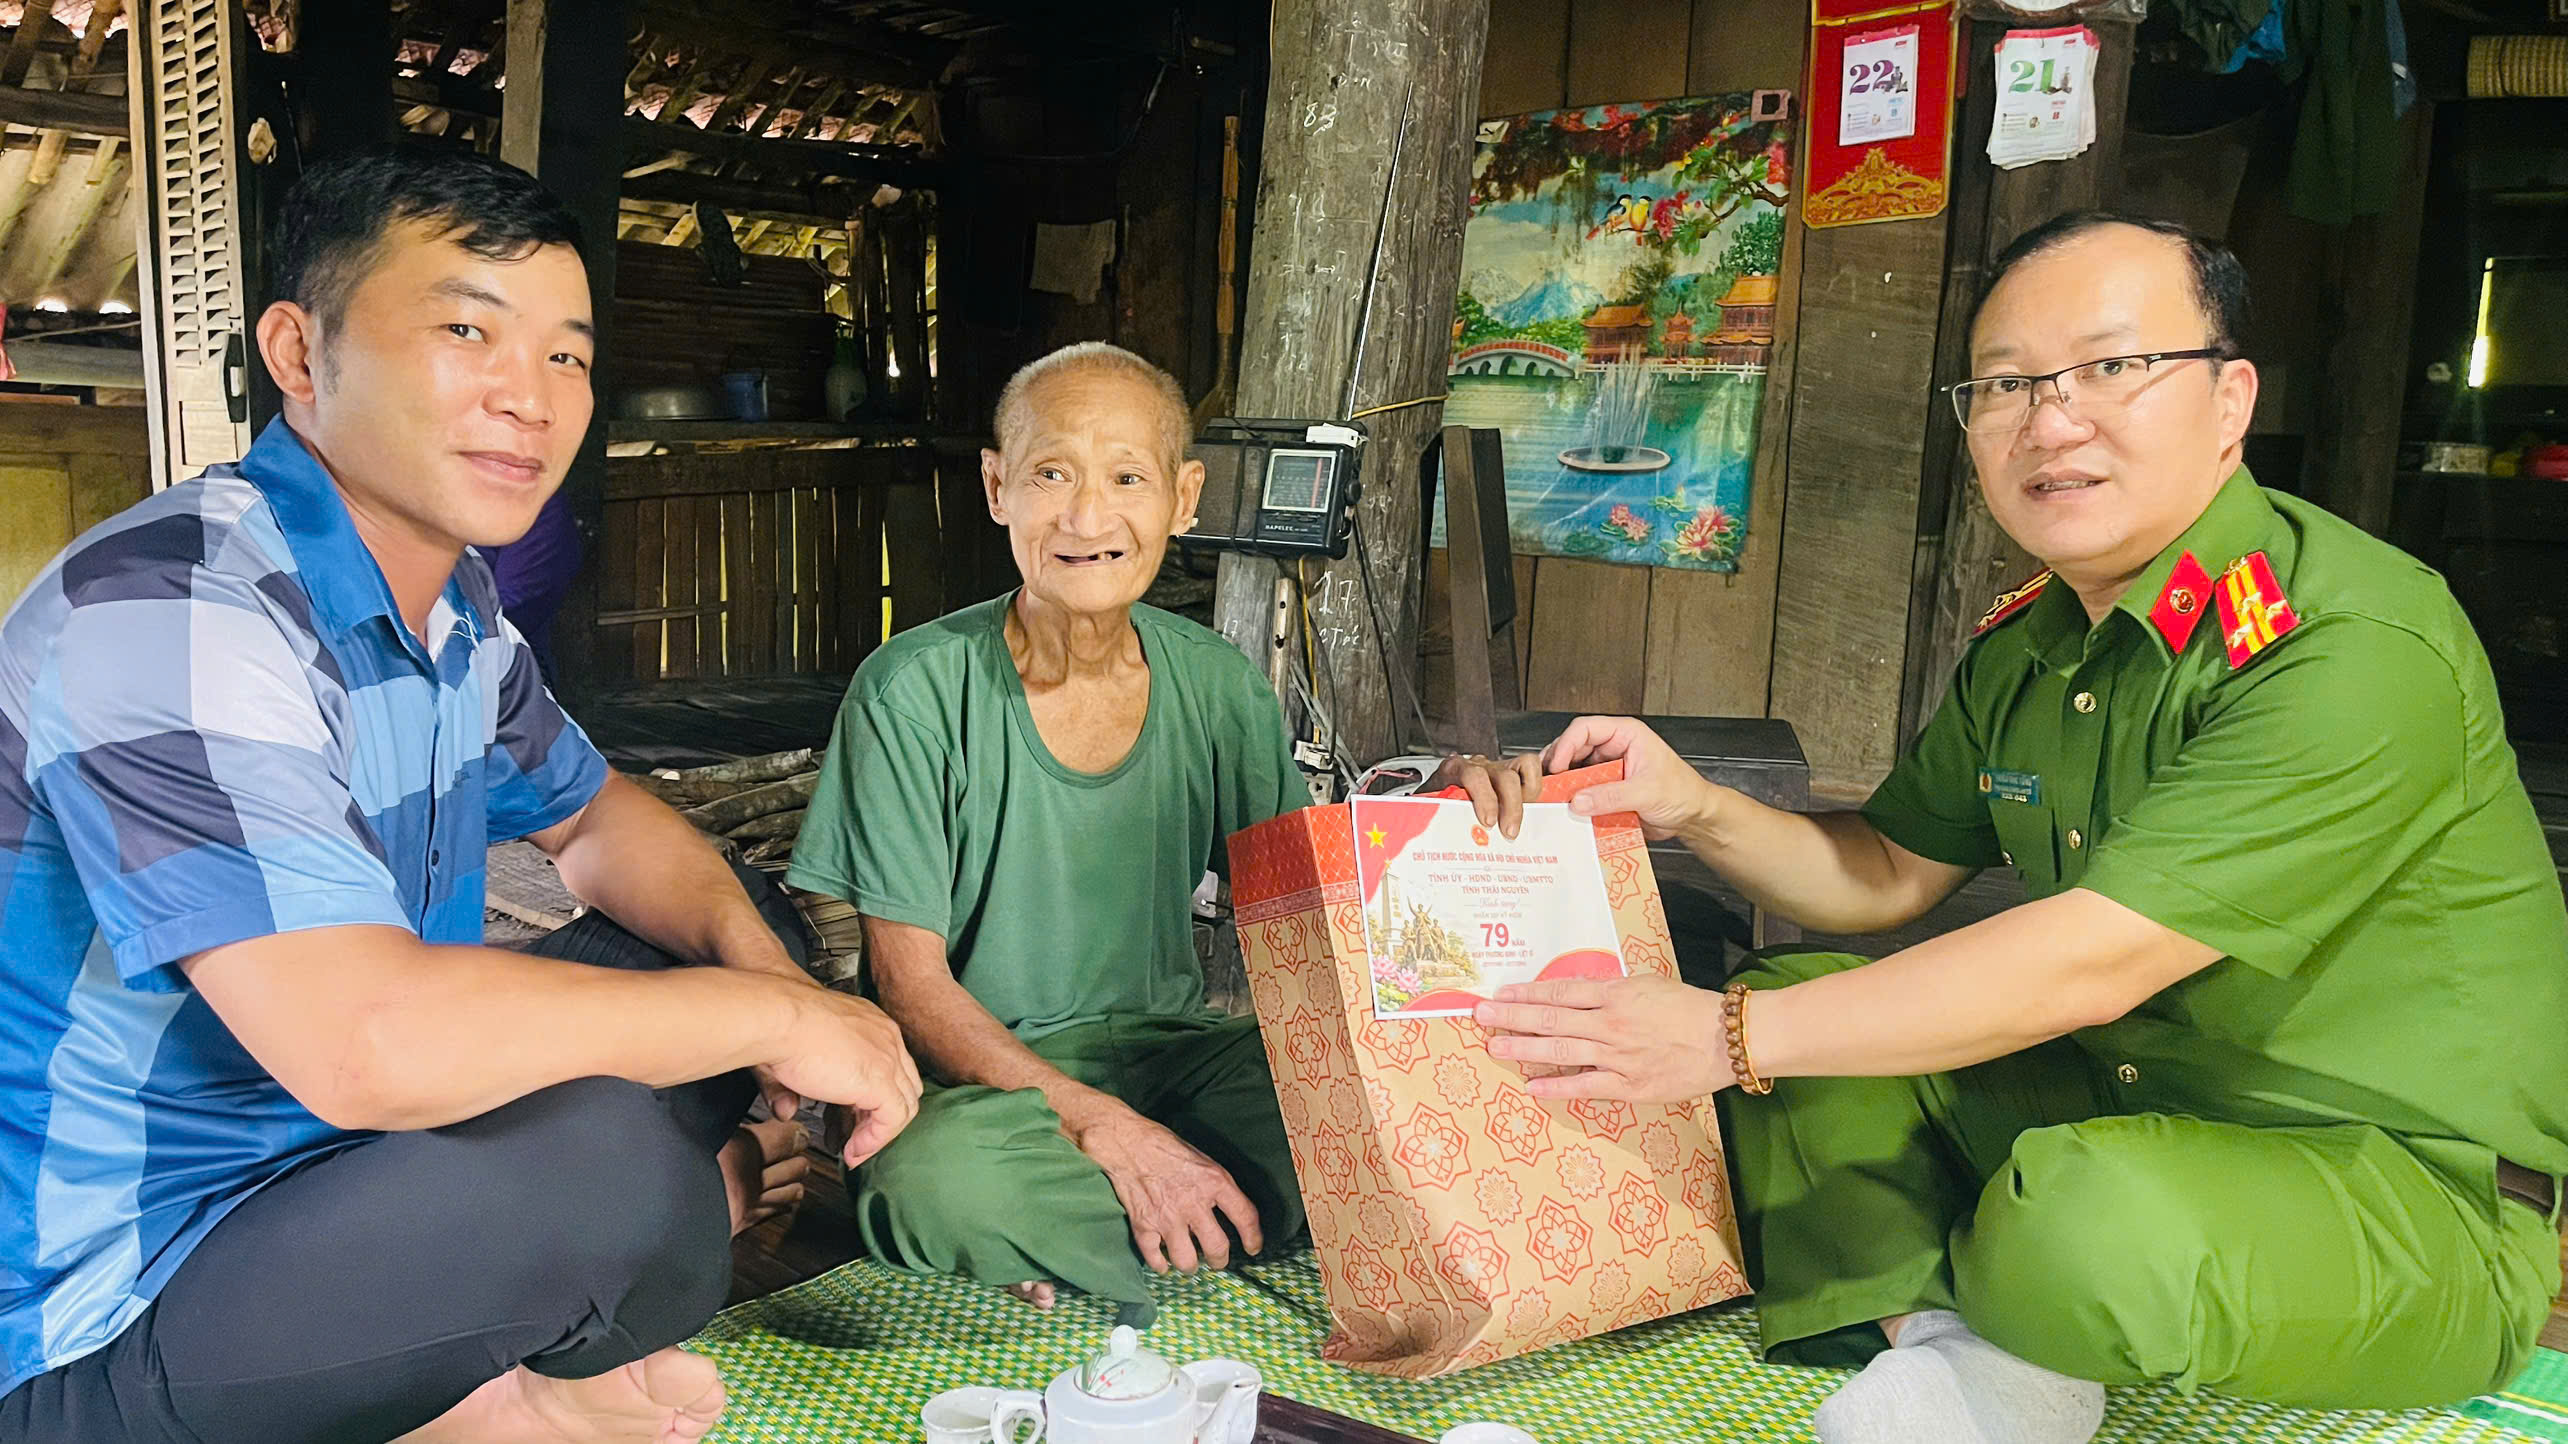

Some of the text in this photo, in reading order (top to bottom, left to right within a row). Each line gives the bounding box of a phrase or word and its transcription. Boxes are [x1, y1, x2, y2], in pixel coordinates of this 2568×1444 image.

[1849, 60, 1895, 95] 22
[2008, 59, 2056, 94] 21
[1480, 922, 1509, 947] 79
